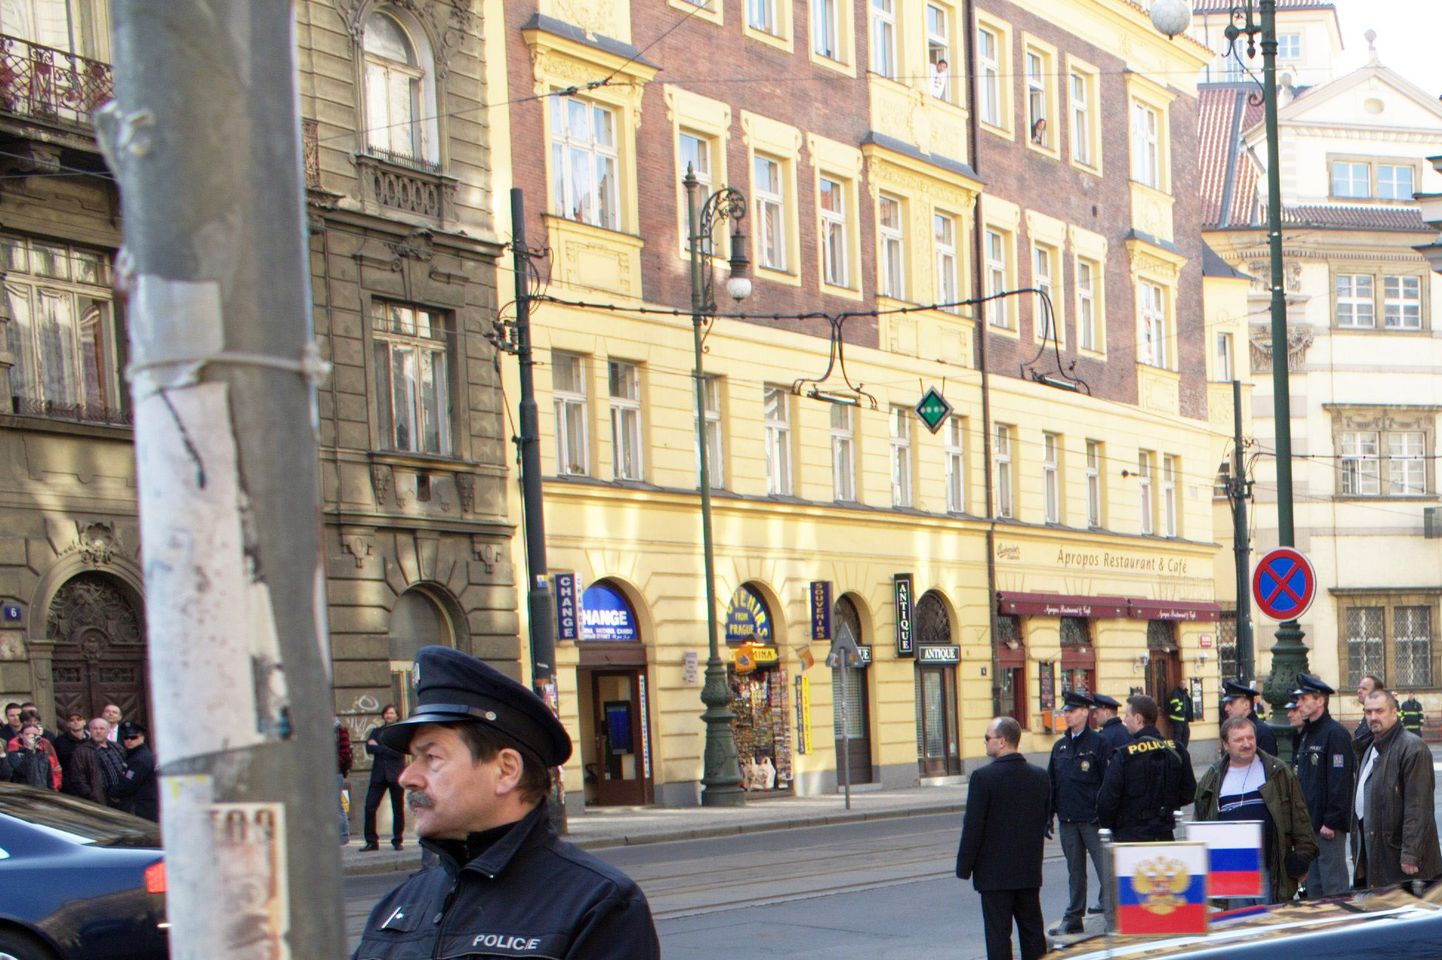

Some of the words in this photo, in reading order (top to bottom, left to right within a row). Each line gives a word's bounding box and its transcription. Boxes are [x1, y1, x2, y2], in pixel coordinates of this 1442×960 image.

[1104, 552, 1155, 570] Restaurant
[11, 607, 17, 617] 6
[561, 577, 573, 638] CHANGE
[815, 583, 824, 638] SOUVENIRS
[900, 584, 909, 649] ANTIQUE
[583, 609, 627, 625] HANGE
[925, 648, 955, 660] ANTIQUE
